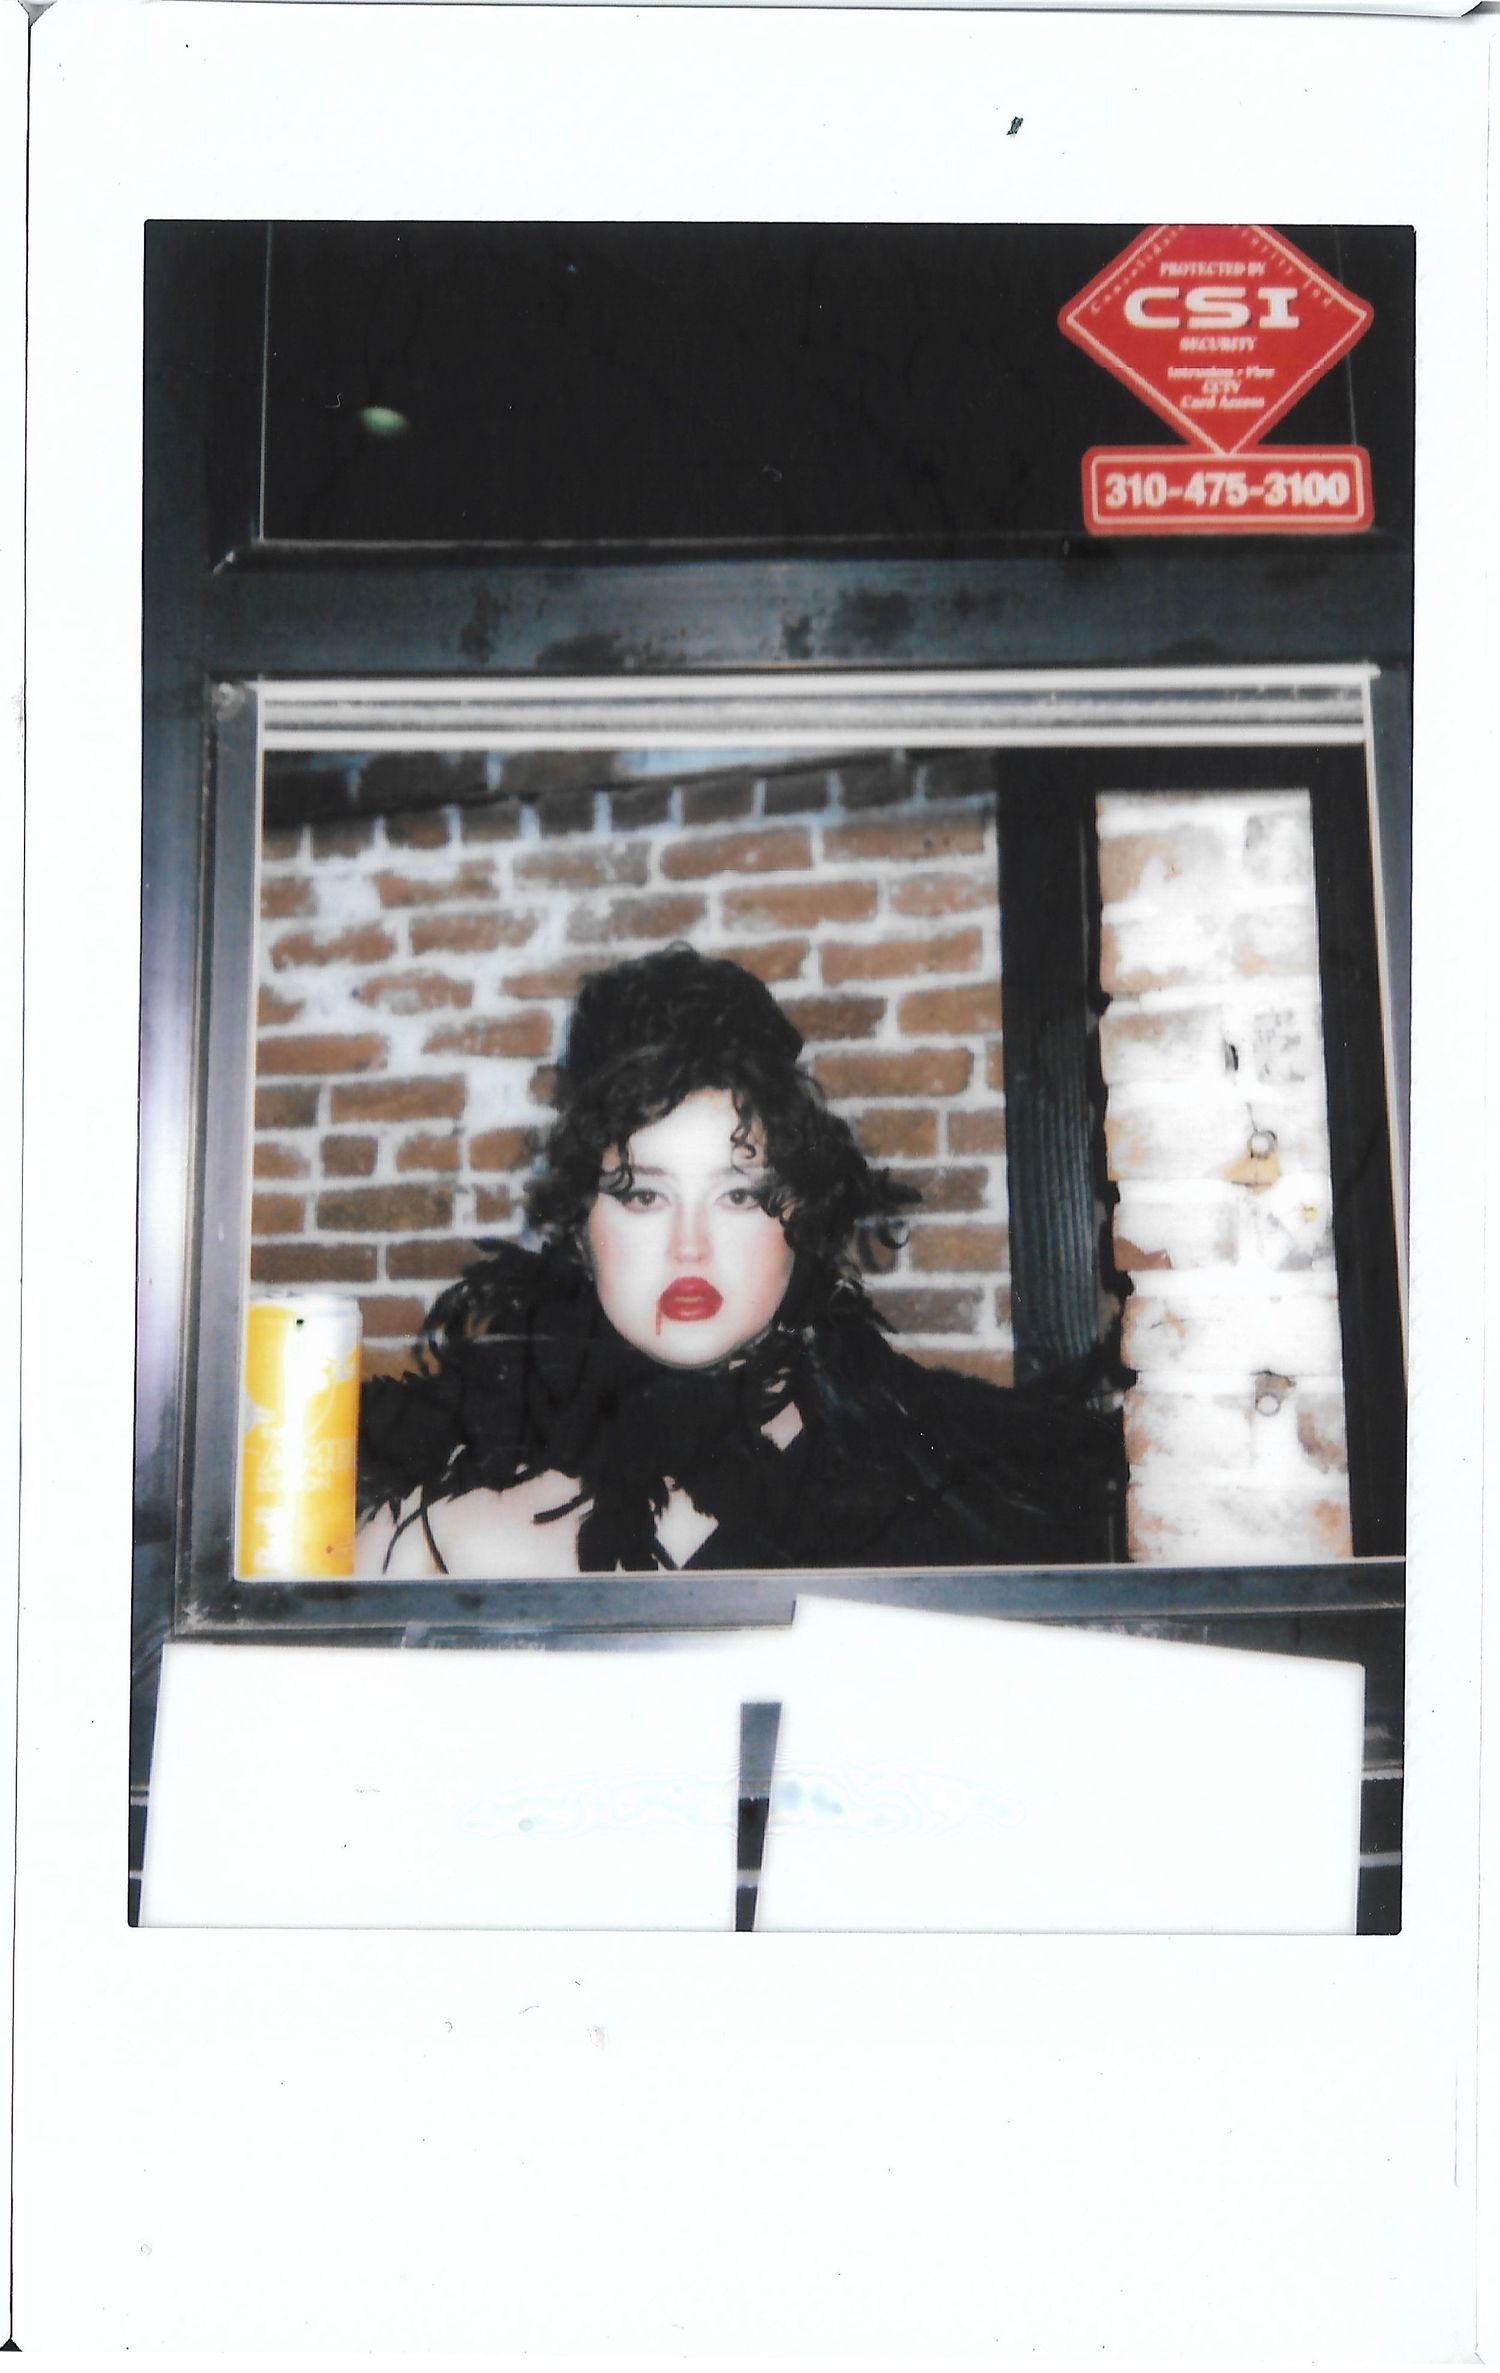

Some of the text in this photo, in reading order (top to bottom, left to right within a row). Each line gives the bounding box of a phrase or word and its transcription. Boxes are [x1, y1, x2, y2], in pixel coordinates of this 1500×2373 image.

[1160, 261, 1266, 277] PROTECTED BY
[1123, 286, 1300, 329] CSI
[1179, 335, 1257, 352] SECURITY
[1201, 378, 1241, 395] CCTV
[1179, 394, 1265, 410] Card Access
[1105, 471, 1350, 507] 310-475-3100
